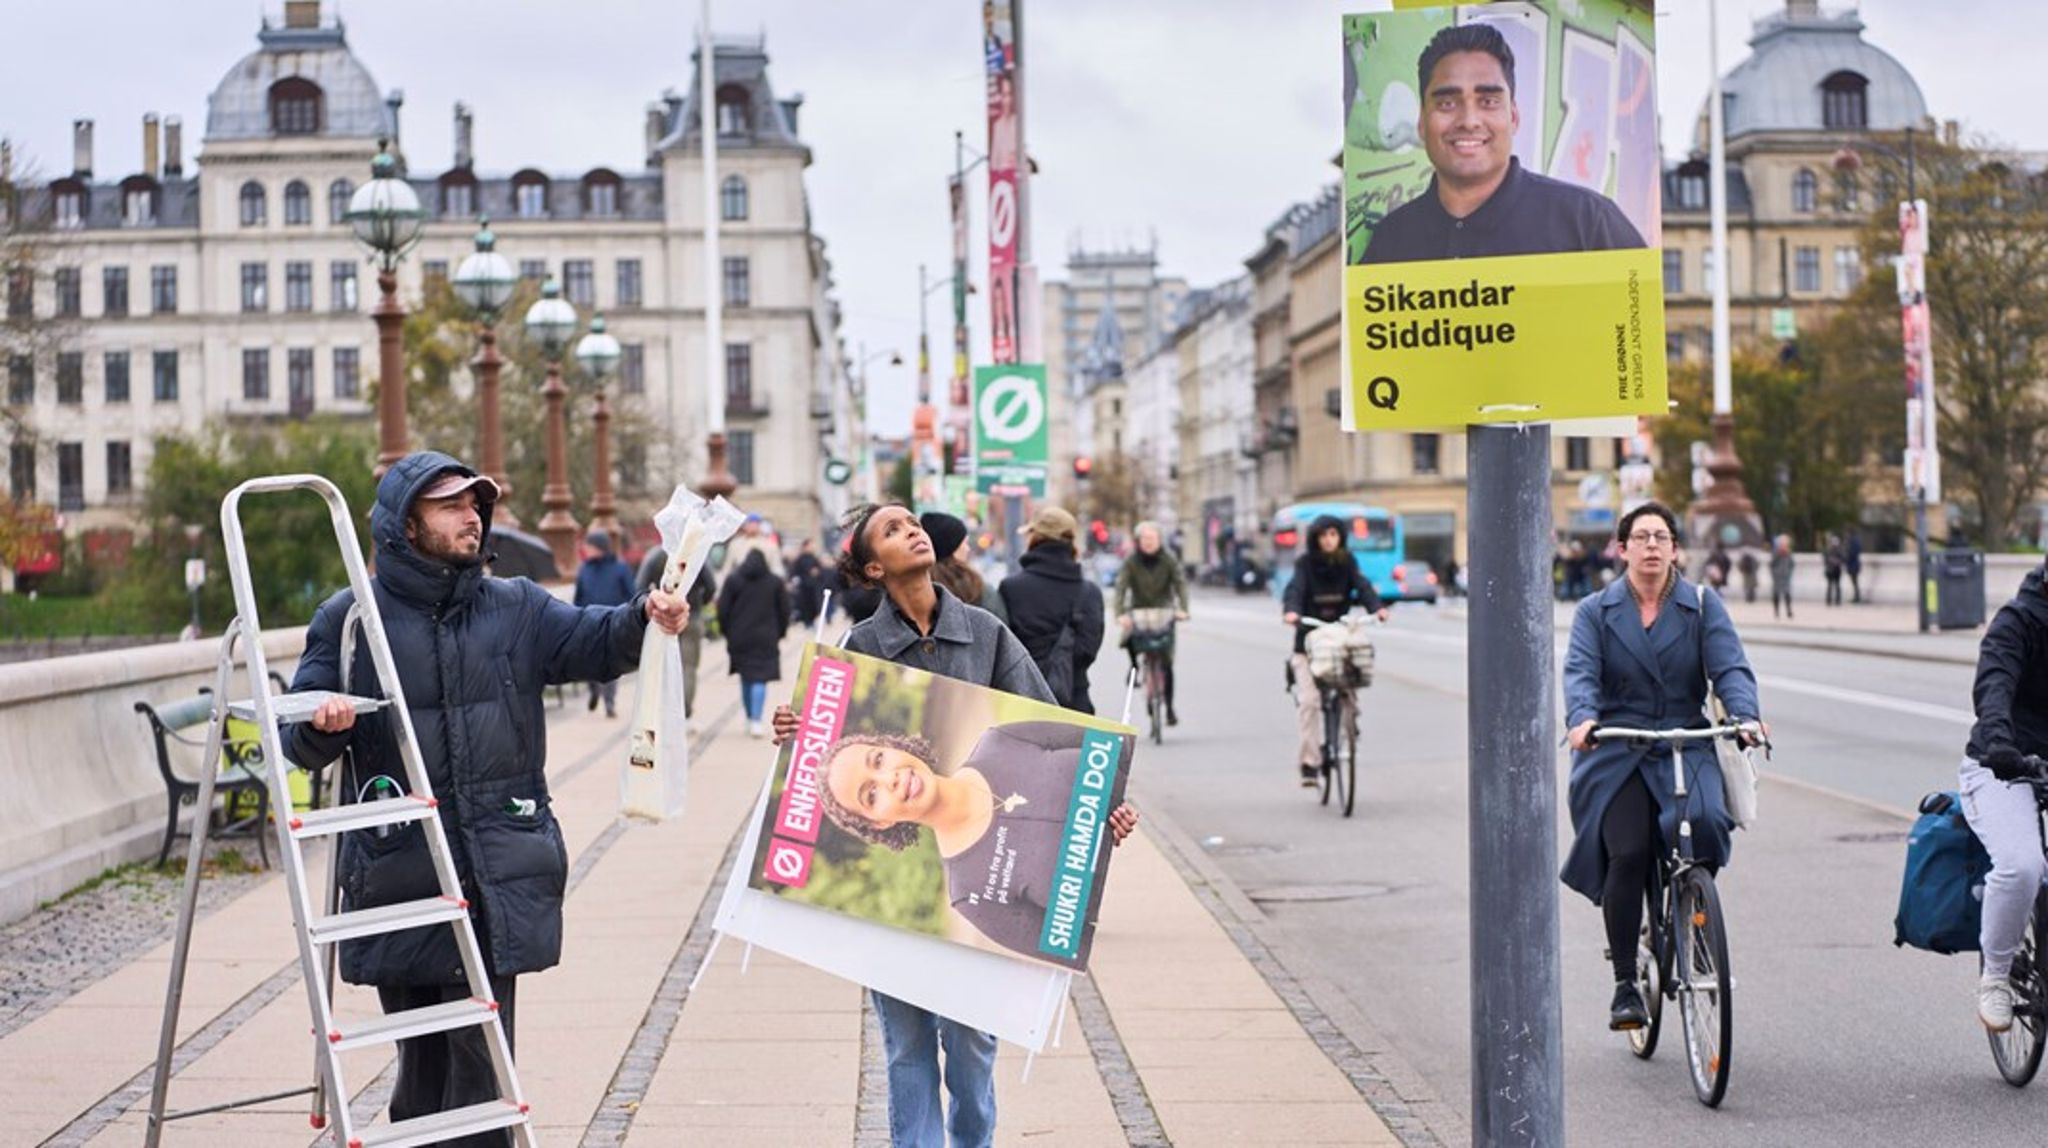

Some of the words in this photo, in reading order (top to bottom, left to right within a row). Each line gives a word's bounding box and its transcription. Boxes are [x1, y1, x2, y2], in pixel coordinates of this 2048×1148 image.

[1364, 279, 1515, 313] Sikandar
[1628, 269, 1641, 350] INDEPENDENT
[1365, 318, 1515, 351] Siddique
[1616, 324, 1627, 372] GRØNNE
[1367, 376, 1400, 411] Q
[1618, 375, 1628, 400] FRIE
[1632, 354, 1644, 399] GREENS
[979, 375, 1043, 443] Ø
[784, 665, 847, 832] ENHEDSLISTEN
[1082, 740, 1112, 790] DOL
[995, 826, 1008, 856] profit
[1065, 794, 1101, 872] HAMDA
[773, 847, 803, 879] Ø
[988, 873, 998, 885] os
[989, 856, 1001, 871] fra
[983, 885, 994, 901] Fri
[997, 889, 1008, 904] på
[1048, 874, 1083, 949] SHUKRI
